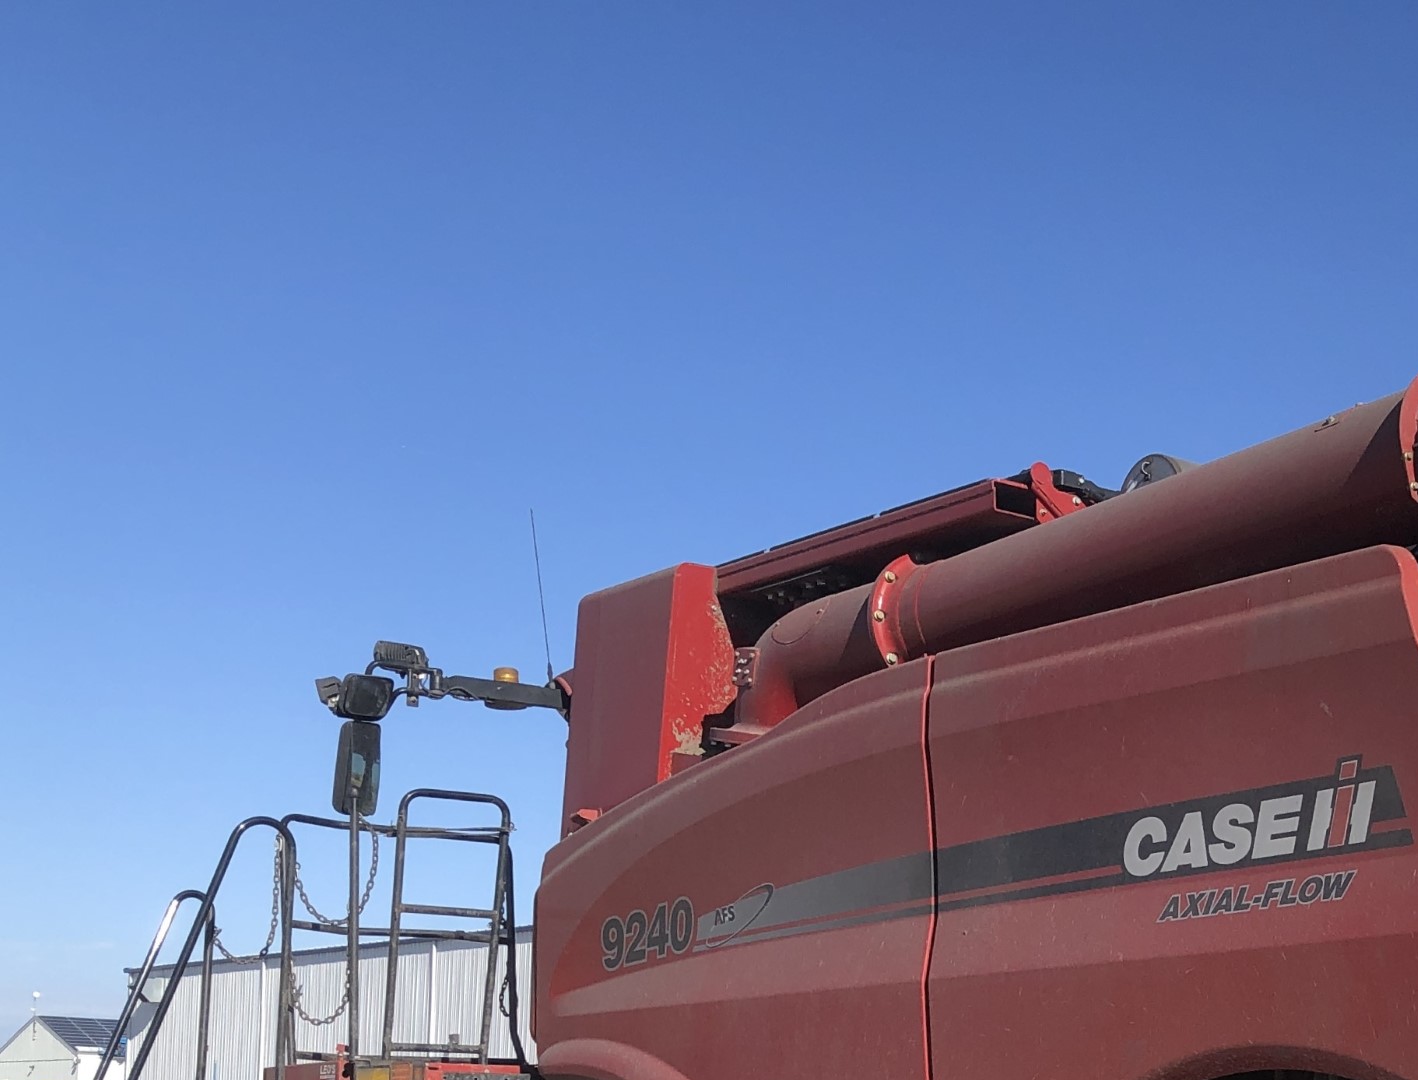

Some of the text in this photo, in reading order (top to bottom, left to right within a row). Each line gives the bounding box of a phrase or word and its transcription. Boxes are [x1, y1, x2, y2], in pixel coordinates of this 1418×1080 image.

[1123, 795, 1303, 877] CASE
[602, 896, 735, 972] 9240 AFS
[1157, 870, 1357, 922] AXIAL-FLOW
